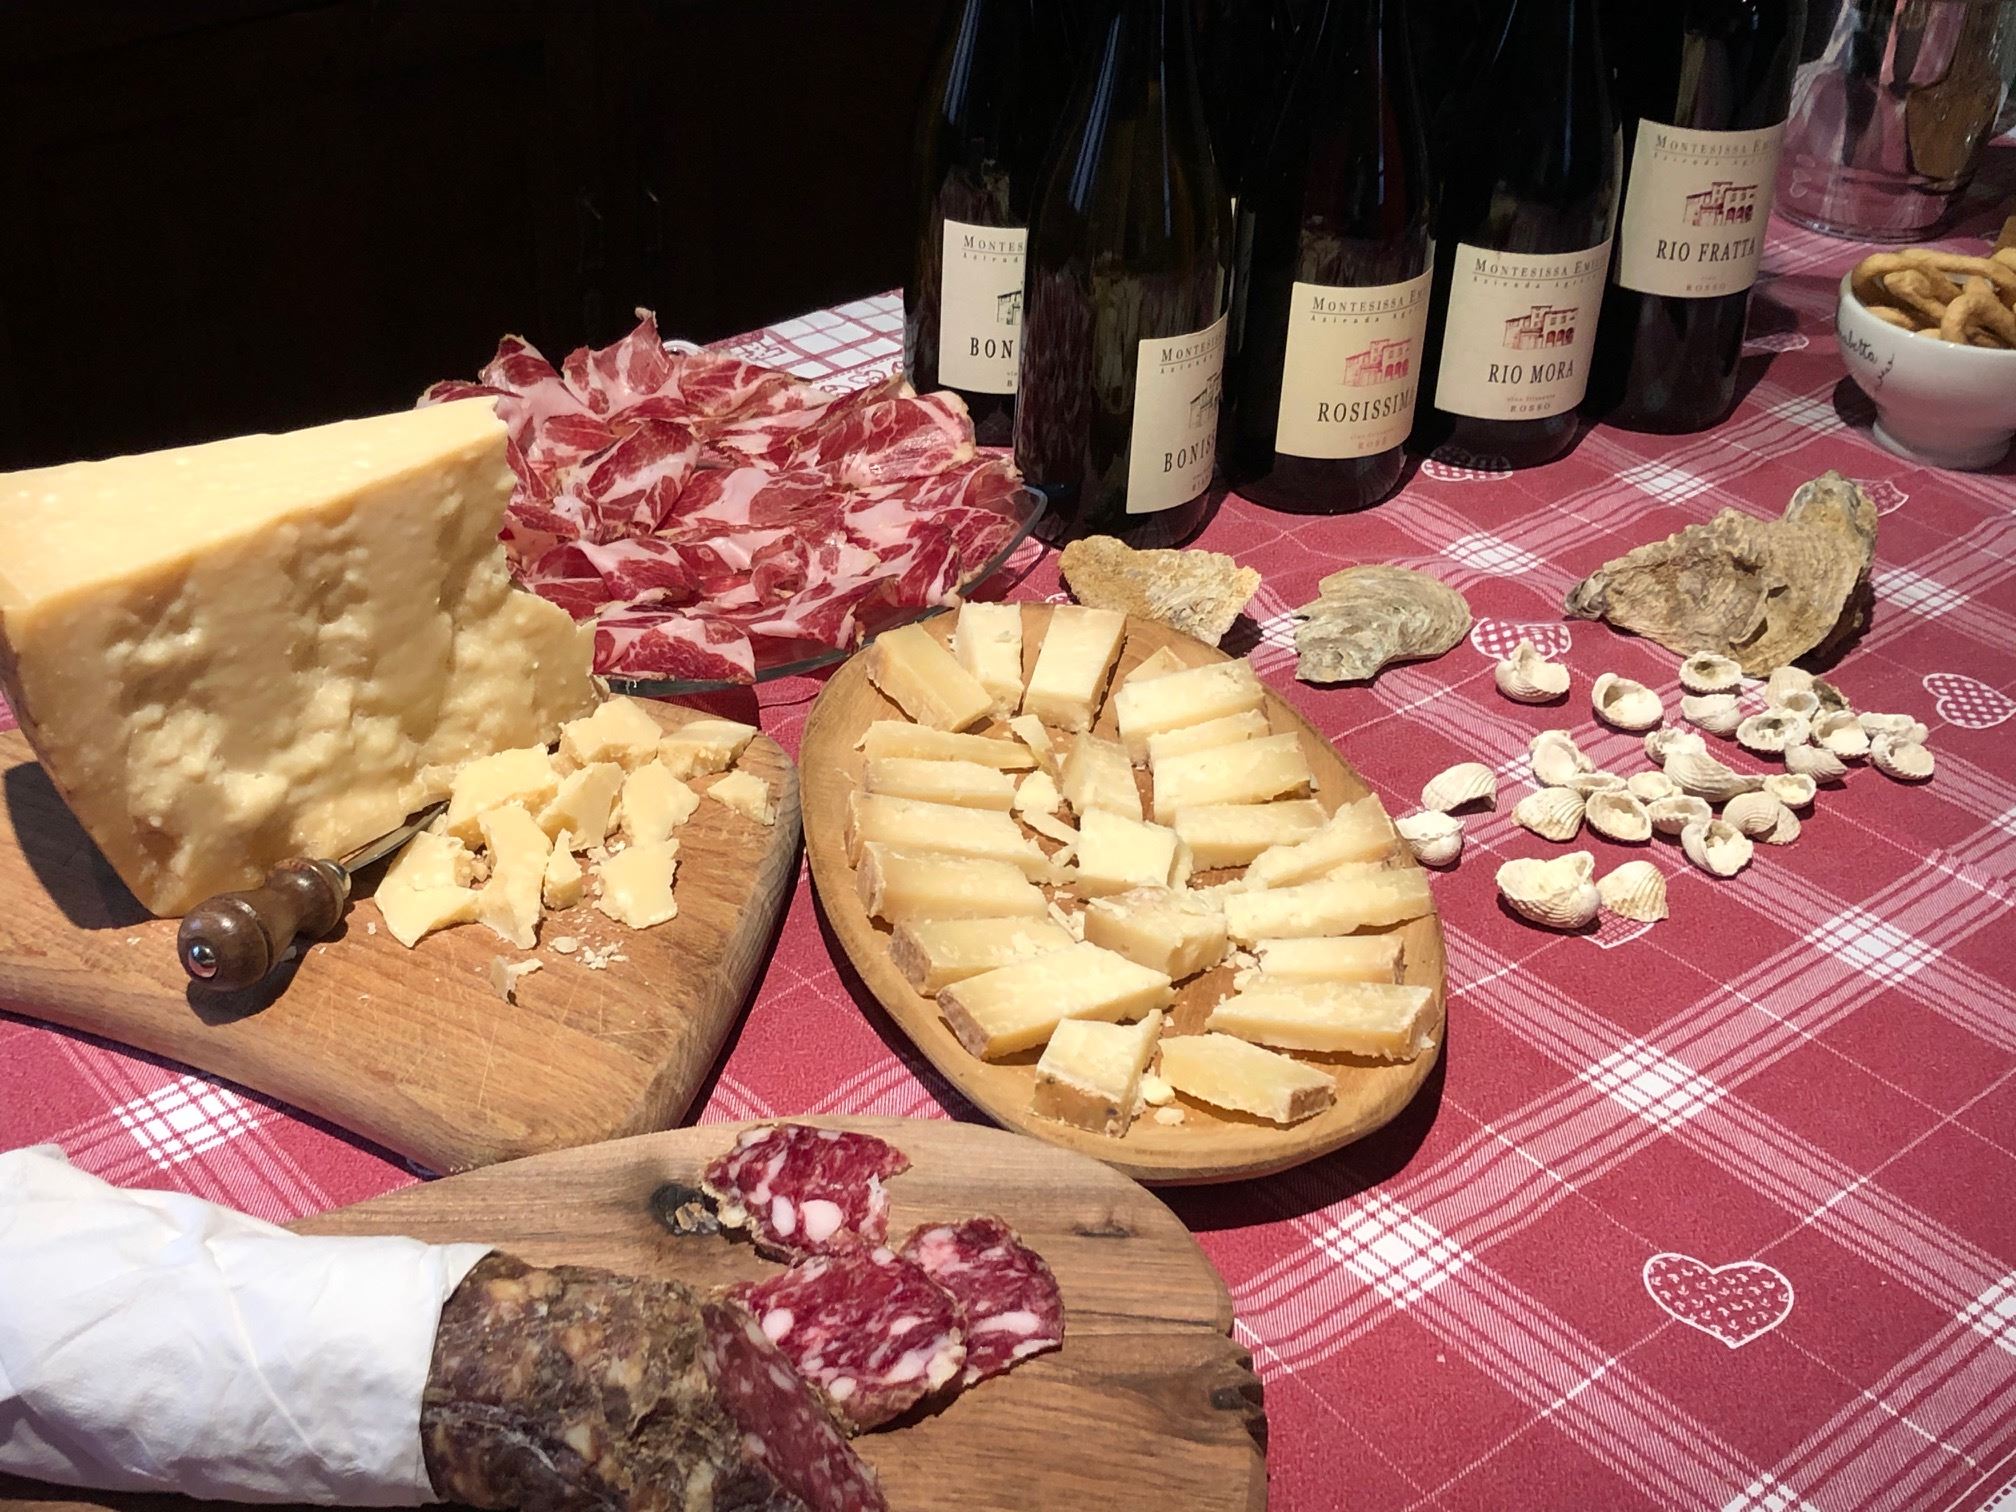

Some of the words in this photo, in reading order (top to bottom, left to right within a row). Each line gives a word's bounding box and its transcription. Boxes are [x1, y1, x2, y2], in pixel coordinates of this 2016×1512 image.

[963, 234, 1024, 252] MONTES
[1656, 239, 1691, 262] RIO
[1698, 237, 1756, 263] FRATTA
[1475, 257, 1568, 278] MONTESISSA
[1312, 296, 1404, 313] MONTESISSA
[969, 336, 1014, 359] BON
[1487, 363, 1523, 384] RIO
[1529, 359, 1574, 384] MORA
[1509, 402, 1551, 413] ROSSO
